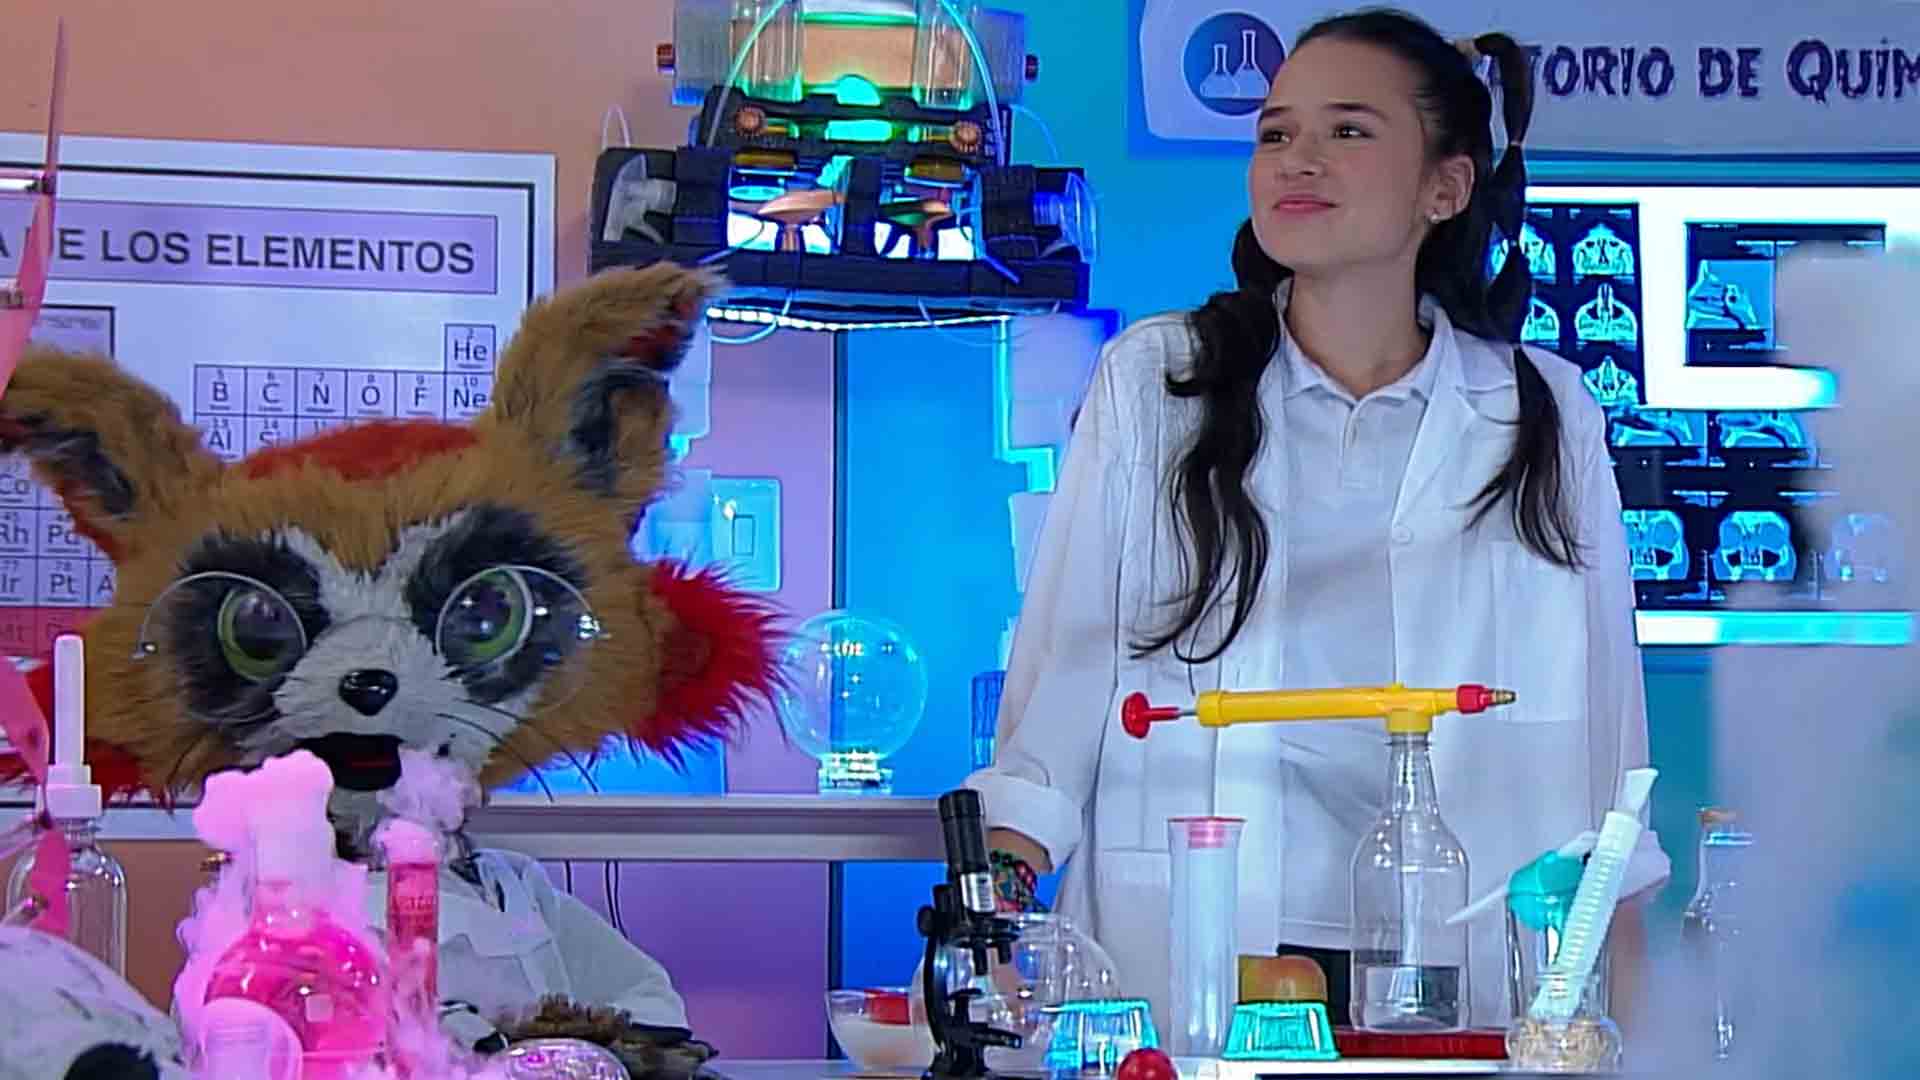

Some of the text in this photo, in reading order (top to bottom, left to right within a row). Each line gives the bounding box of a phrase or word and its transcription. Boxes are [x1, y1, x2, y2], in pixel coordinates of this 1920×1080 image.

[1698, 47, 1762, 97] DE
[101, 229, 191, 264] LOS
[206, 233, 475, 275] ELEMENTOS
[453, 339, 489, 361] He
[212, 382, 229, 402] B
[262, 383, 281, 404] C
[312, 384, 331, 405] N
[361, 385, 381, 406] O
[414, 387, 430, 407] F
[453, 388, 488, 408] Ne
[208, 430, 232, 450] Al
[50, 573, 80, 594] Pt
